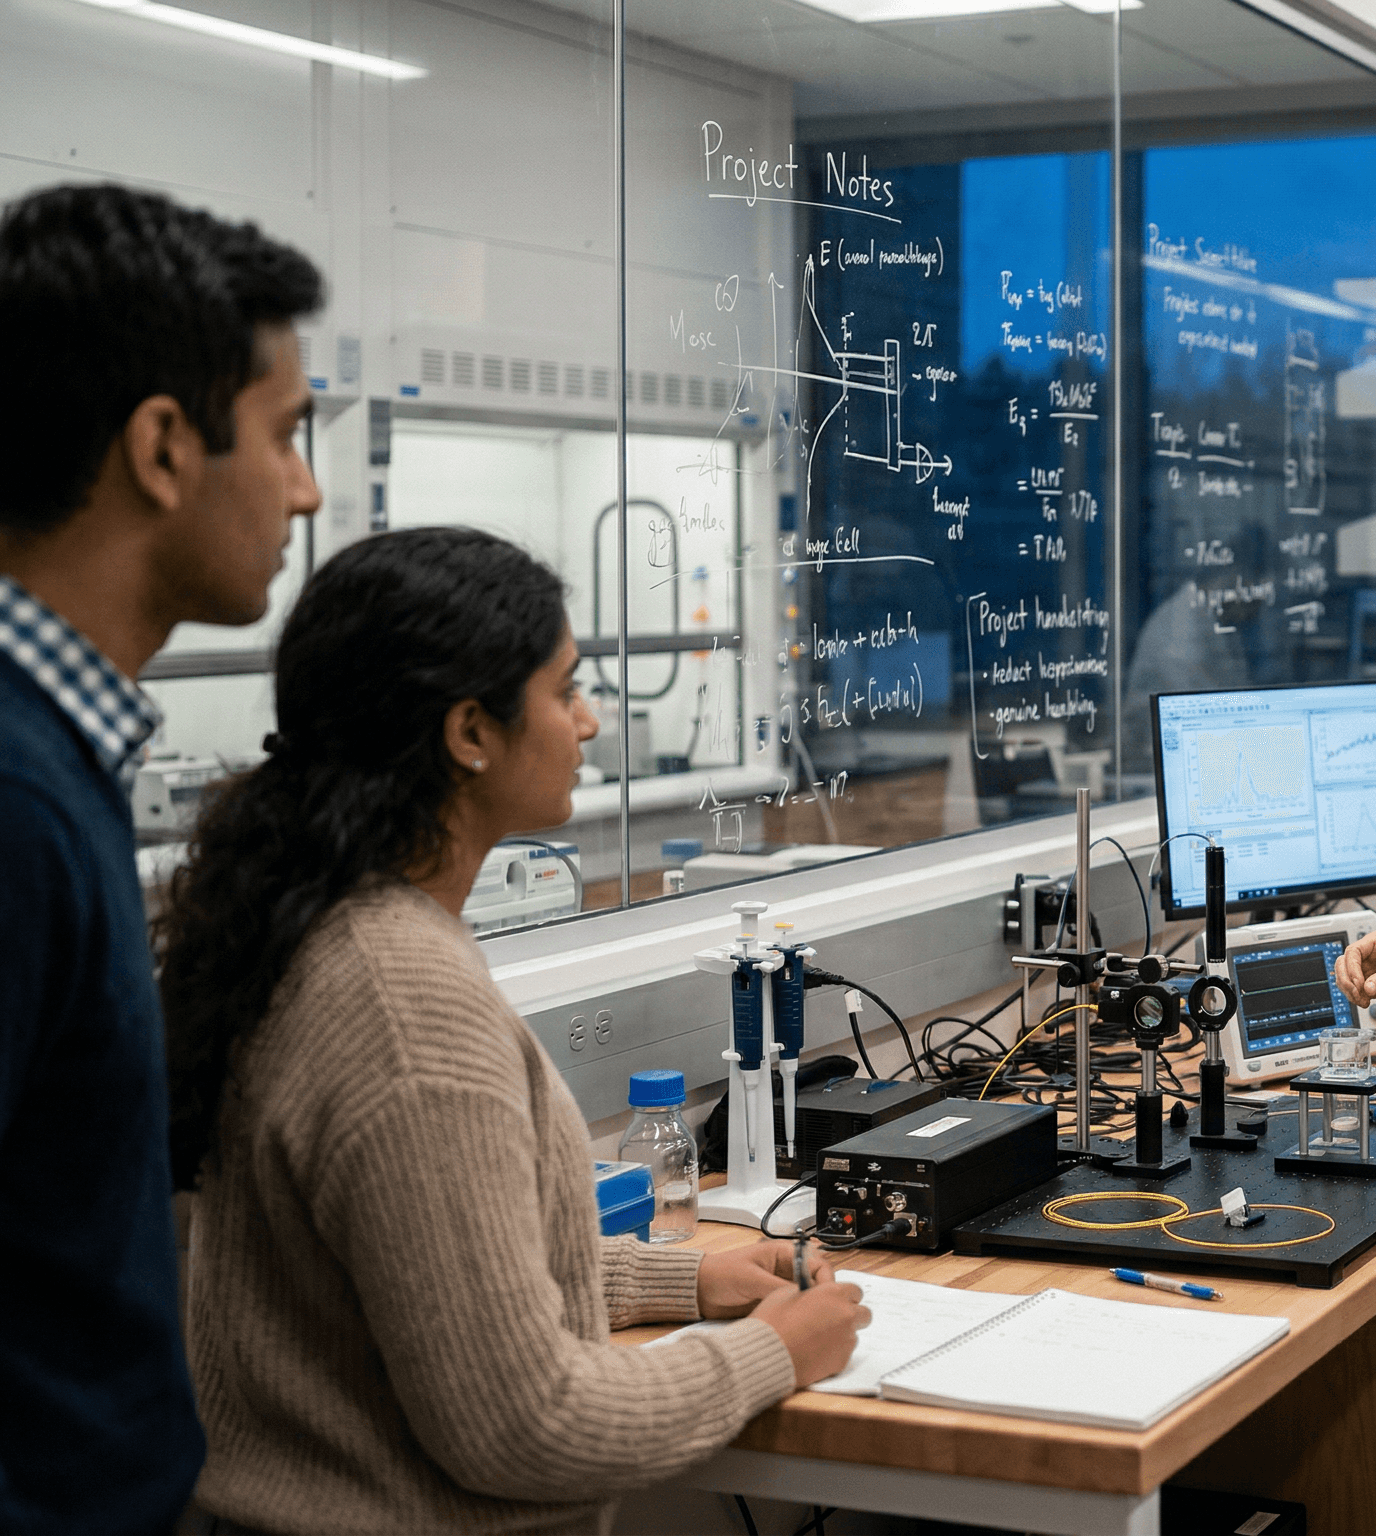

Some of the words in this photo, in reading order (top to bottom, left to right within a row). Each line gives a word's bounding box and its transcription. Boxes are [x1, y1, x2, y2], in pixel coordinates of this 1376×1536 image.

[701, 120, 798, 208] Project
[826, 151, 895, 207] Notes
[979, 600, 1028, 648] Project
